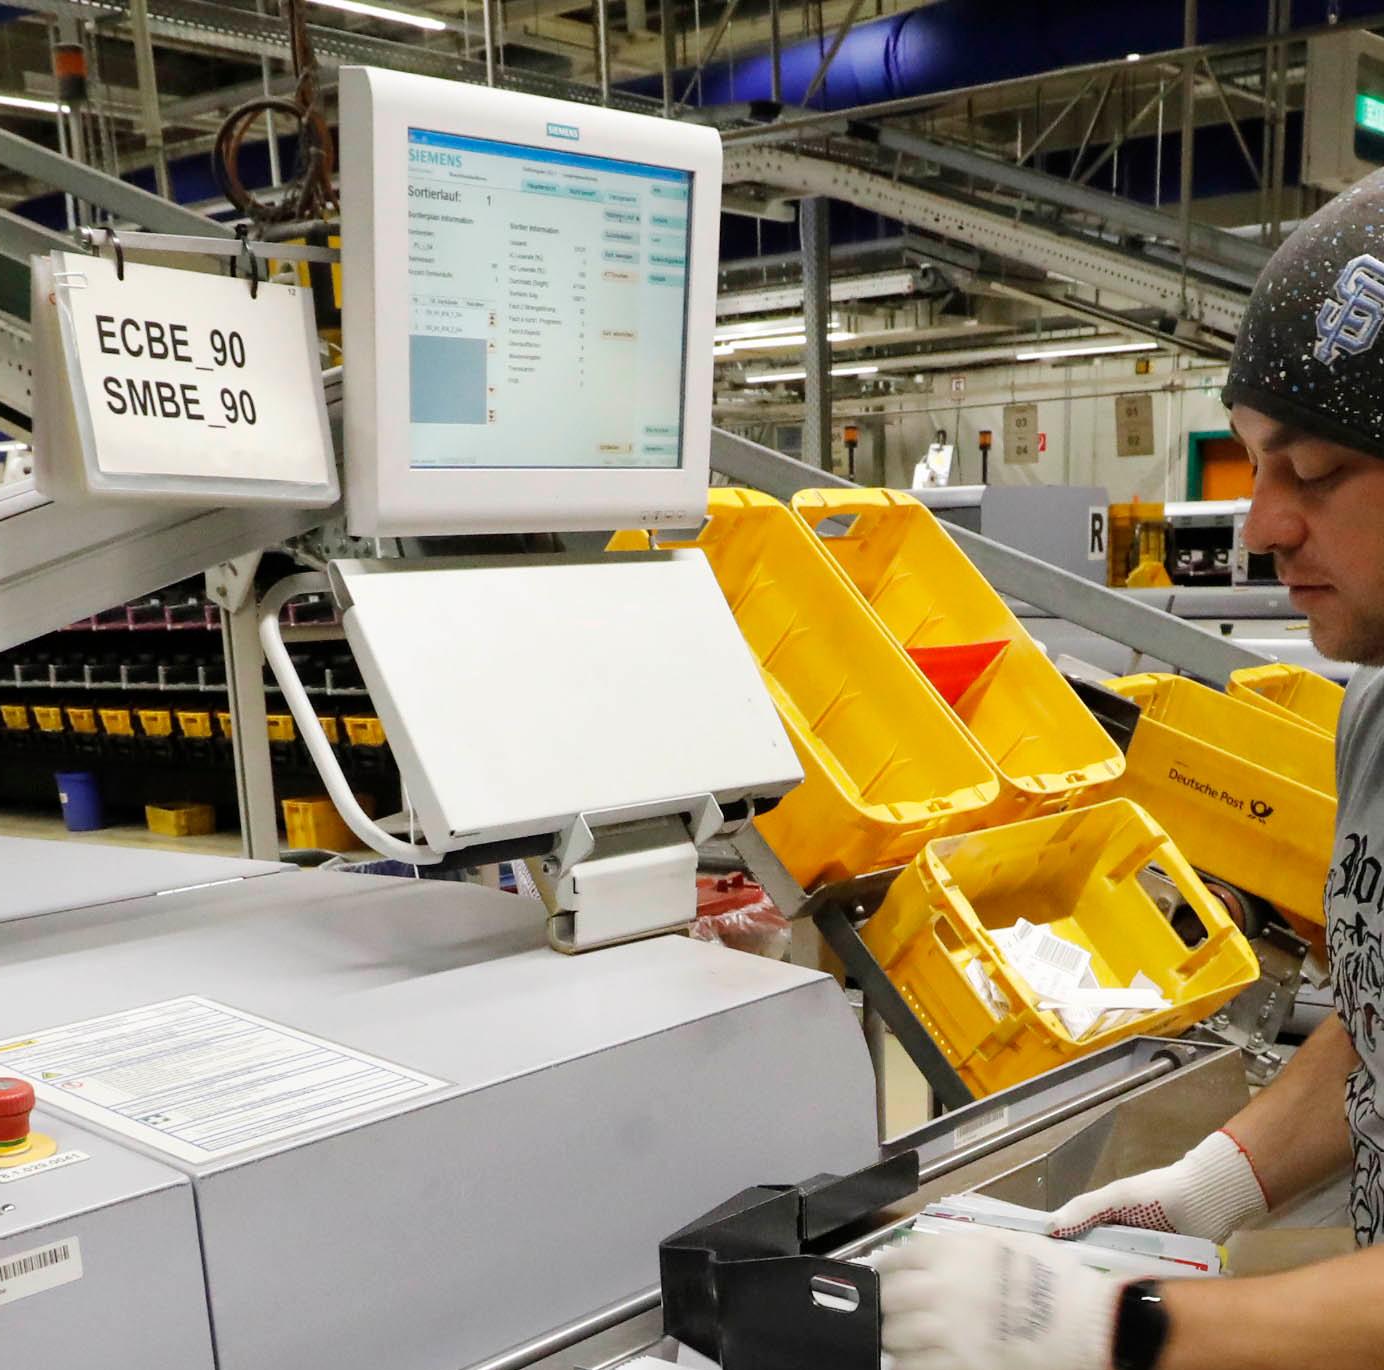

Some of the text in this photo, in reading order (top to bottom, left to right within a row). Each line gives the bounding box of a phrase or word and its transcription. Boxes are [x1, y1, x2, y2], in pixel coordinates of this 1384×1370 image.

[408, 149, 463, 168] SIEMENS
[408, 185, 462, 203] Sortierlauf:
[95, 314, 246, 371] ECBE_90
[103, 376, 257, 428] SMBE_90
[1091, 513, 1103, 552] R
[1168, 768, 1244, 810] Deutsche Post
